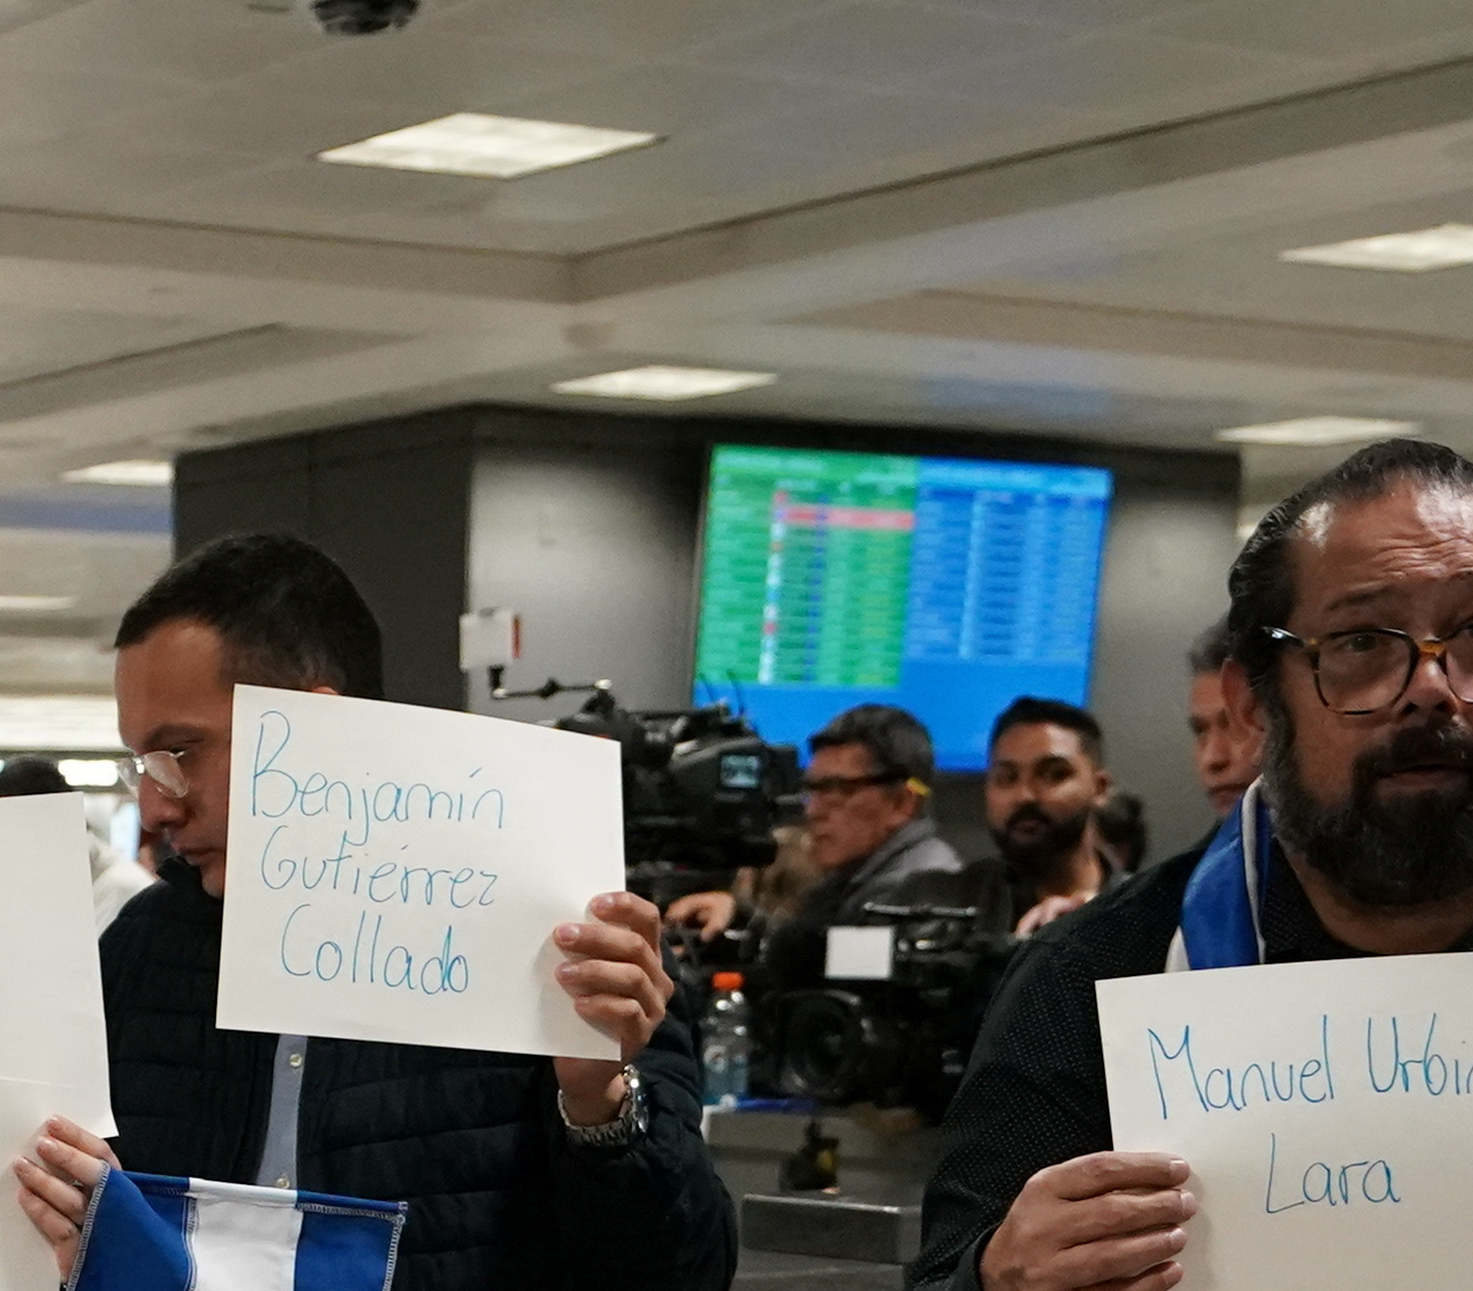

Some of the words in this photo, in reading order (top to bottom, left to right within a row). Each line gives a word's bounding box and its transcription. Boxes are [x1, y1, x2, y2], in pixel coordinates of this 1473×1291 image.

[252, 710, 504, 846] Benjamín
[261, 825, 498, 909] Gutiérrez
[281, 903, 469, 995] Collado
[1147, 1014, 1334, 1120] Manuel
[1266, 1132, 1401, 1214] Lara
